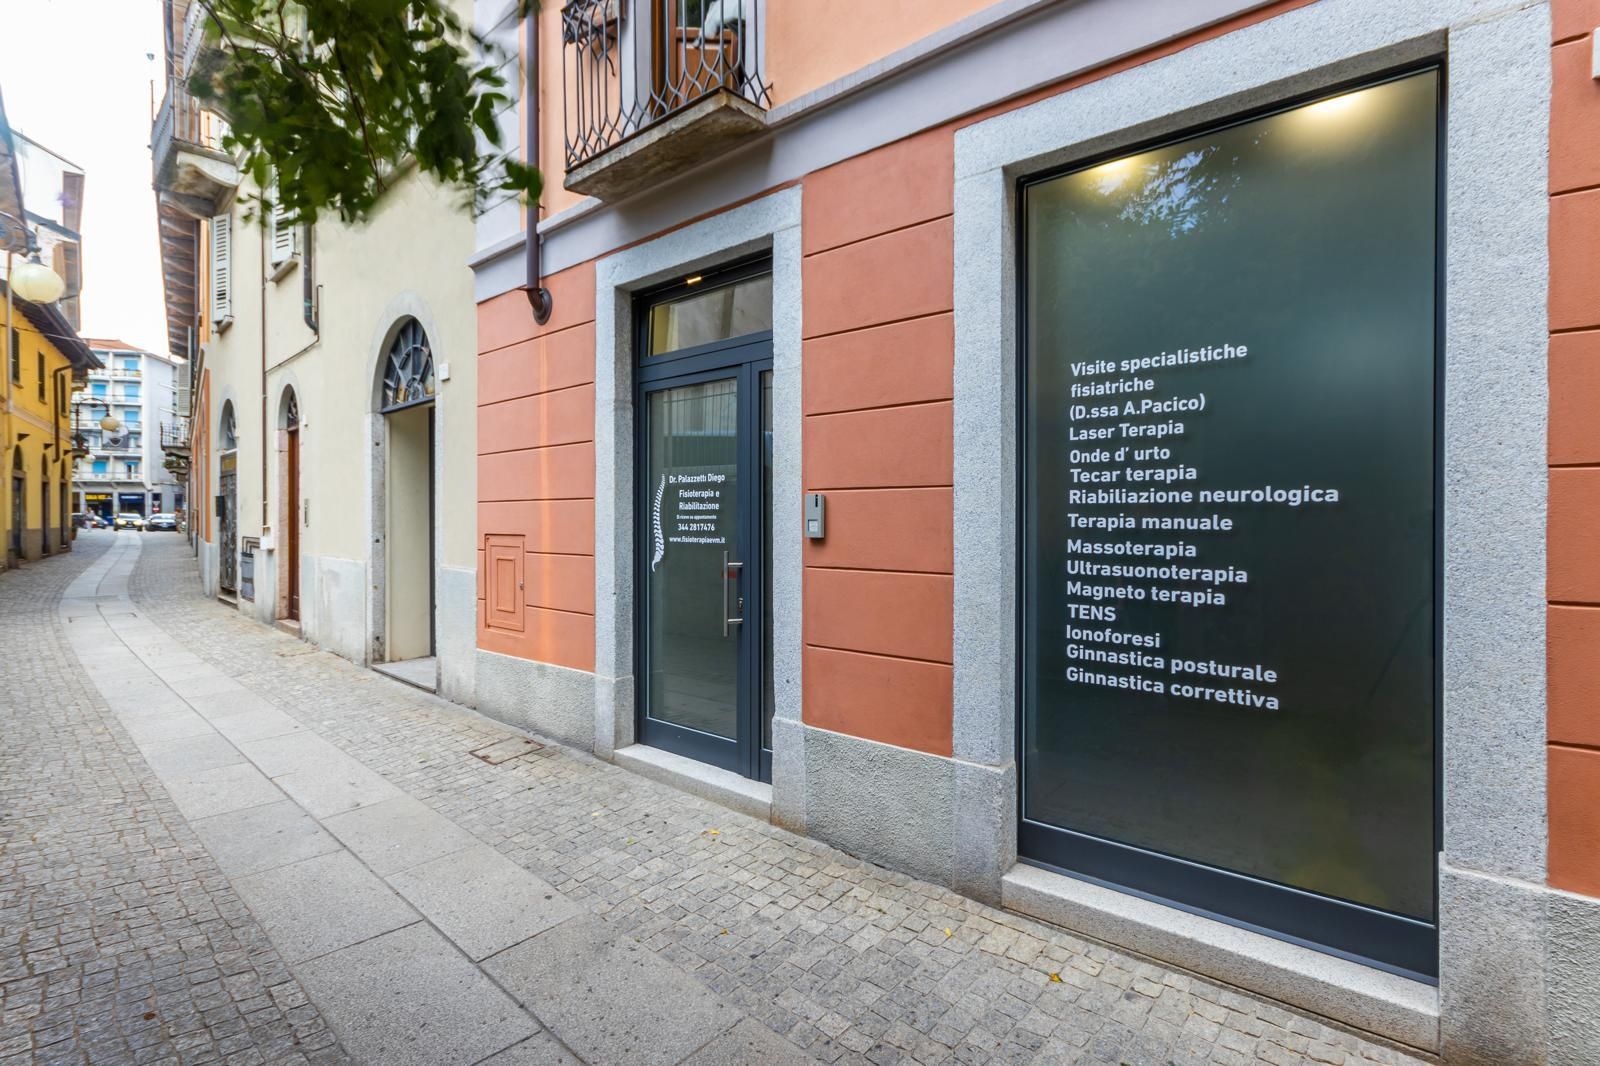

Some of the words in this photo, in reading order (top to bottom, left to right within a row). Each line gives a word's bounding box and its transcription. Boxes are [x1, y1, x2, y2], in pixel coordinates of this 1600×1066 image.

[1070, 359, 1116, 377] Visite
[1121, 344, 1248, 373] specialistiche
[1070, 377, 1155, 397] fisiatriche
[1069, 404, 1118, 421] (D.ssa
[1123, 393, 1206, 415] A.Pacico)
[1069, 426, 1115, 441] Laser
[1119, 420, 1184, 439] Terapia
[1070, 449, 1110, 463] Onde
[1134, 446, 1171, 460] urto
[708, 474, 725, 483] Diego
[1070, 468, 1121, 483] Tecar
[1126, 466, 1197, 484] terapia
[679, 489, 714, 498] Fisioterapia
[1069, 488, 1193, 504] Riabiliazione
[1200, 485, 1339, 506] neurologica
[679, 502, 719, 510] Riabilitazione
[1067, 513, 1136, 531] Terapia
[1142, 513, 1233, 531] manuale
[1067, 539, 1197, 559] Massoterapia
[1067, 560, 1248, 583] Ultrasuonoterapia
[1067, 581, 1146, 601] Magneto
[1151, 586, 1226, 606] terapia
[1067, 604, 1117, 622] TENS
[1066, 625, 1161, 648] Ionoforesi
[1066, 644, 1164, 669] Ginnastica
[1171, 658, 1278, 683] posturale
[1066, 667, 1164, 693] Ginnastica
[1171, 683, 1279, 710] correttiva
